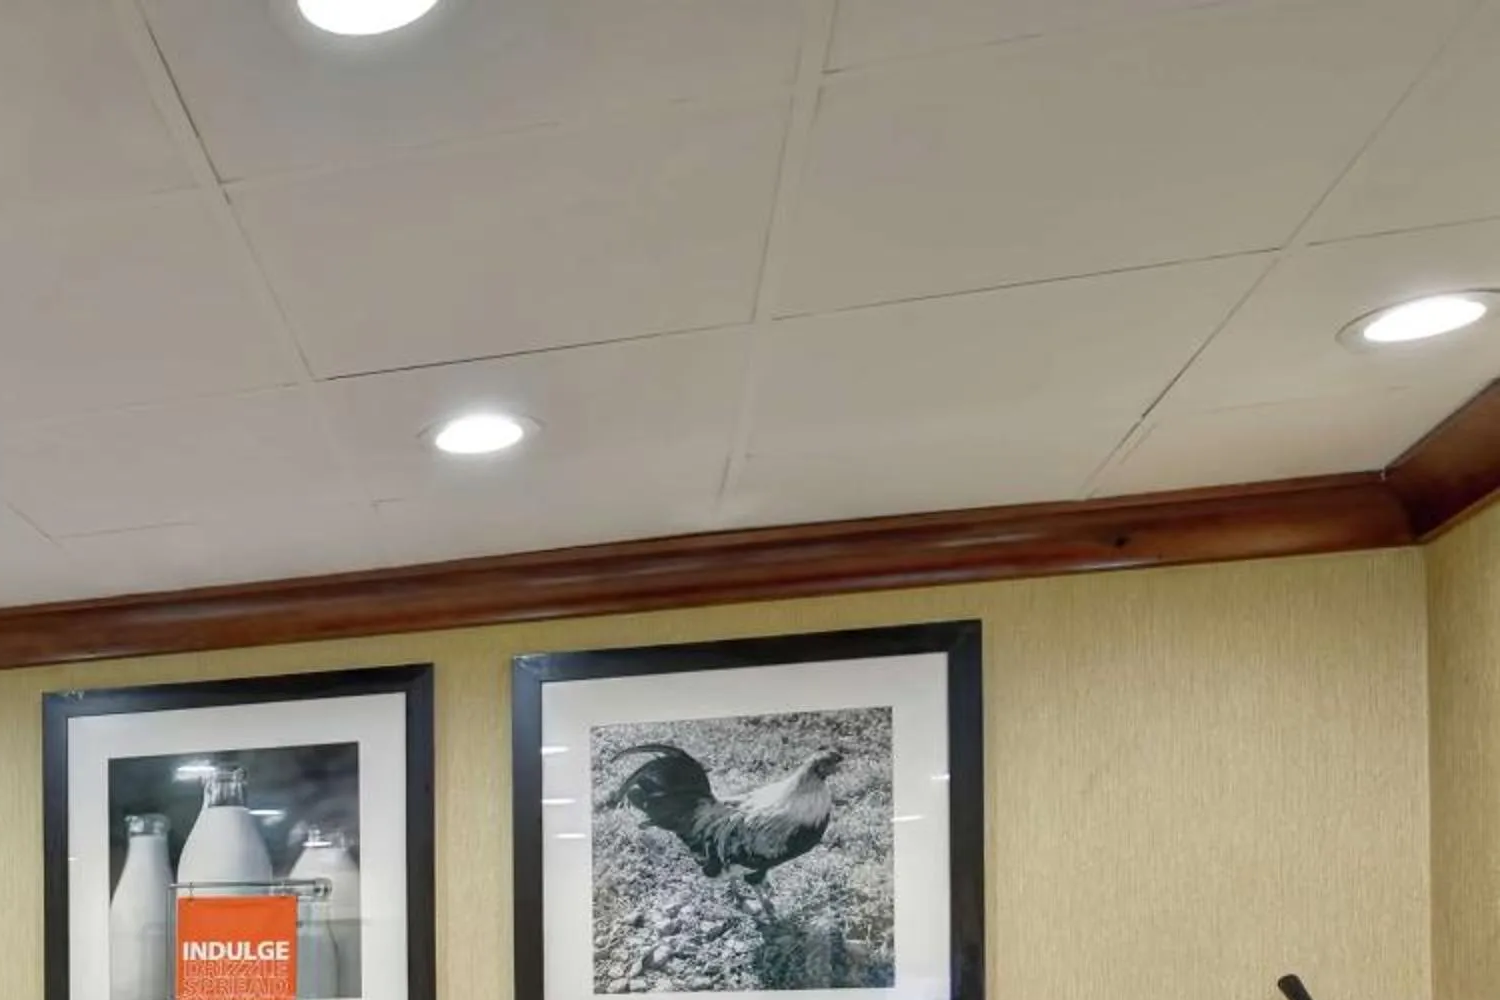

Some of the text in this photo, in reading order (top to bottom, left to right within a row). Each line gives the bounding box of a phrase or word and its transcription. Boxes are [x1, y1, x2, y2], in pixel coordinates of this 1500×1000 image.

[183, 941, 290, 961] INDULGE
[183, 960, 289, 979] DRIZZLE
[183, 977, 291, 997] SPREAD
